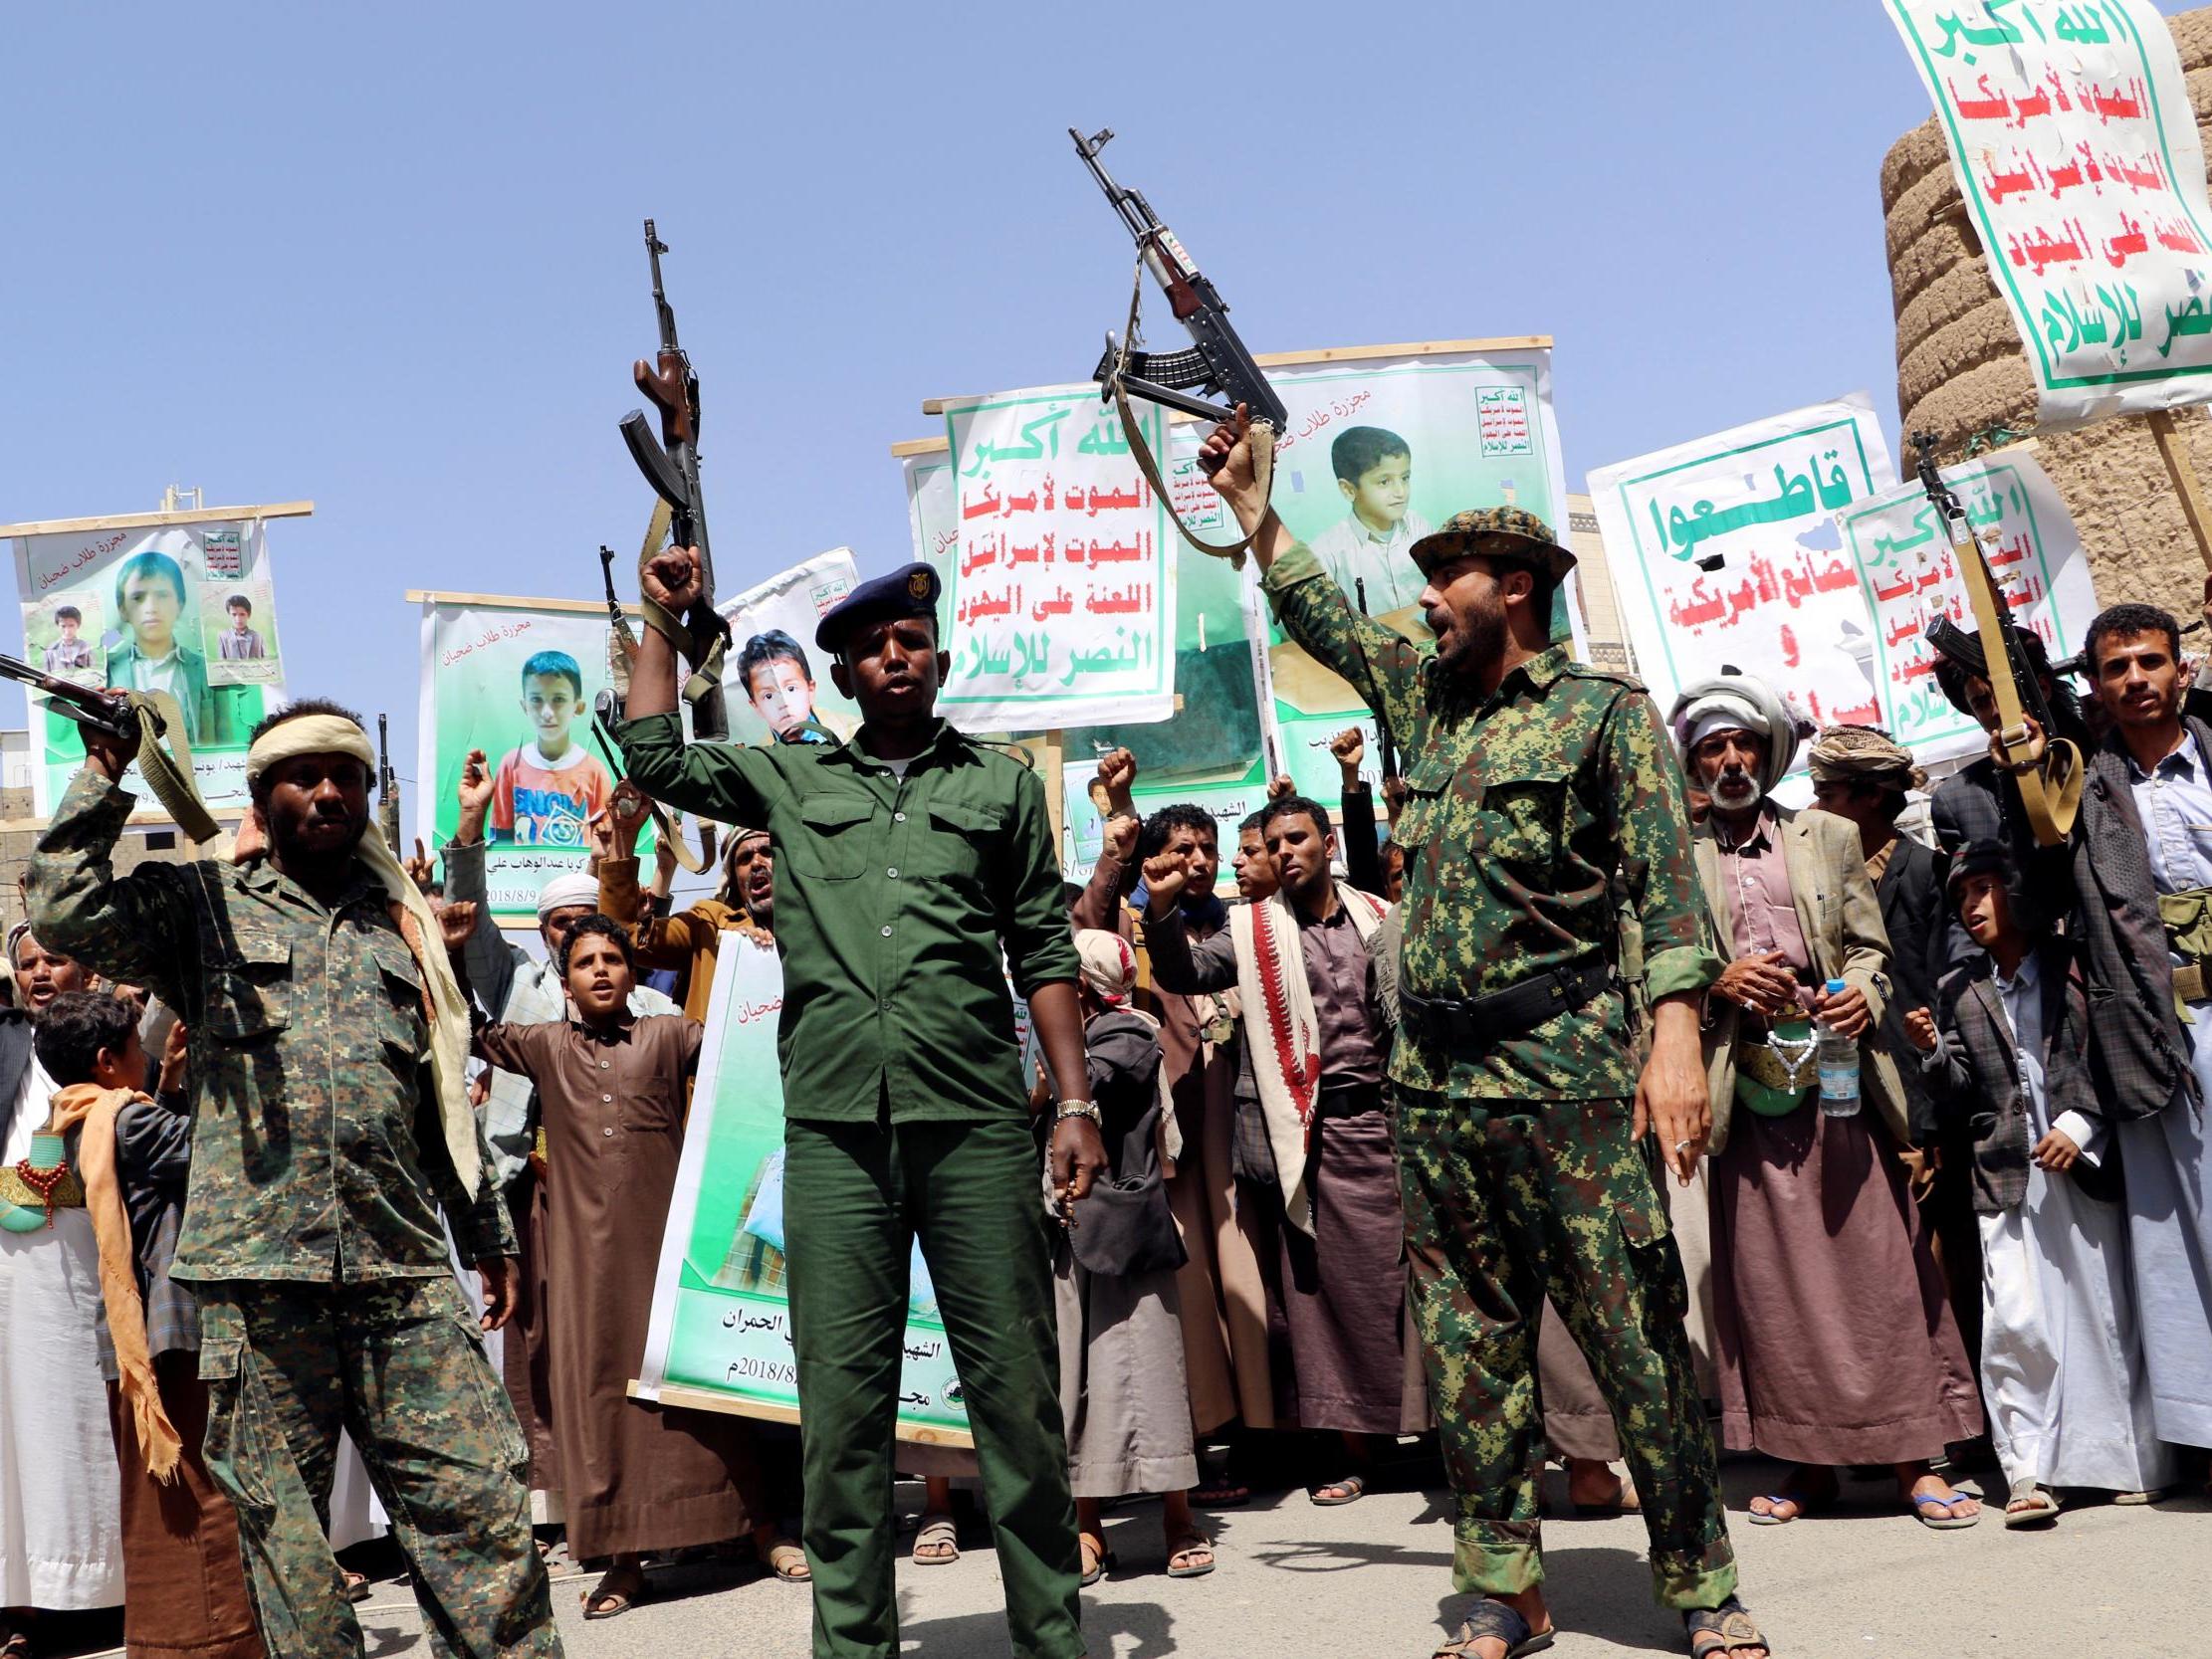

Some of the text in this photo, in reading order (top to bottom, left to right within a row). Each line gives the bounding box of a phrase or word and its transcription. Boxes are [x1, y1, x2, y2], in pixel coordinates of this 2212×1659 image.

[2075, 77, 2149, 126] الموت
[2102, 150, 2169, 195] الموت
[2008, 216, 2094, 277] اليهود
[2101, 208, 2148, 269] على
[1298, 390, 1371, 440] مجزرة طلاب
[1065, 477, 1152, 518] الموت
[1649, 449, 1854, 562] قاطعوا
[1966, 483, 2022, 527] الله
[73, 547, 97, 571] طلاب
[96, 532, 126, 553] مجزرة
[1065, 528, 1152, 570] الموت
[957, 582, 1152, 627] اللعنة على اليهود
[442, 620, 532, 667] مجزرة طلاب ضحيان
[1059, 626, 1152, 687] النصر
[486, 856, 507, 876] علي
[738, 994, 782, 1024] ضحيان
[723, 1308, 782, 1333] الحمران
